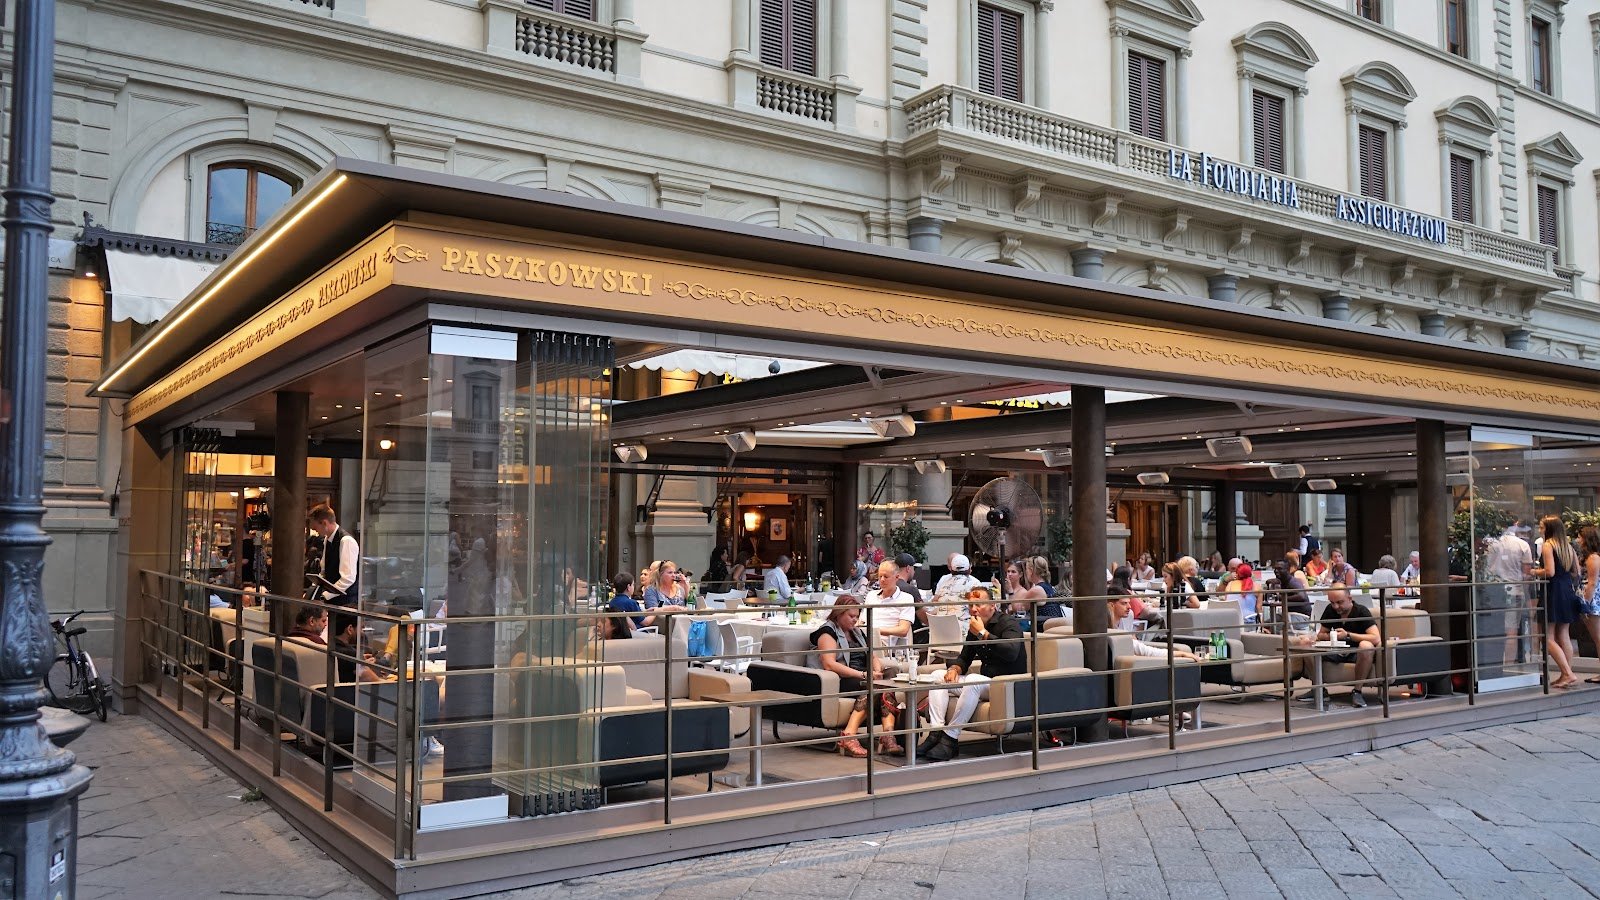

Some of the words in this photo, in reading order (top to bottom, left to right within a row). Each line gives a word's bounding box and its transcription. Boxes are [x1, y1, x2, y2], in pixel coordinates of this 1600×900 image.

[1169, 149, 1192, 181] LA
[1200, 152, 1299, 209] FONDIARIA
[1336, 194, 1447, 244] ASSICURAZIONI
[441, 246, 653, 296] PASZKOWSKI
